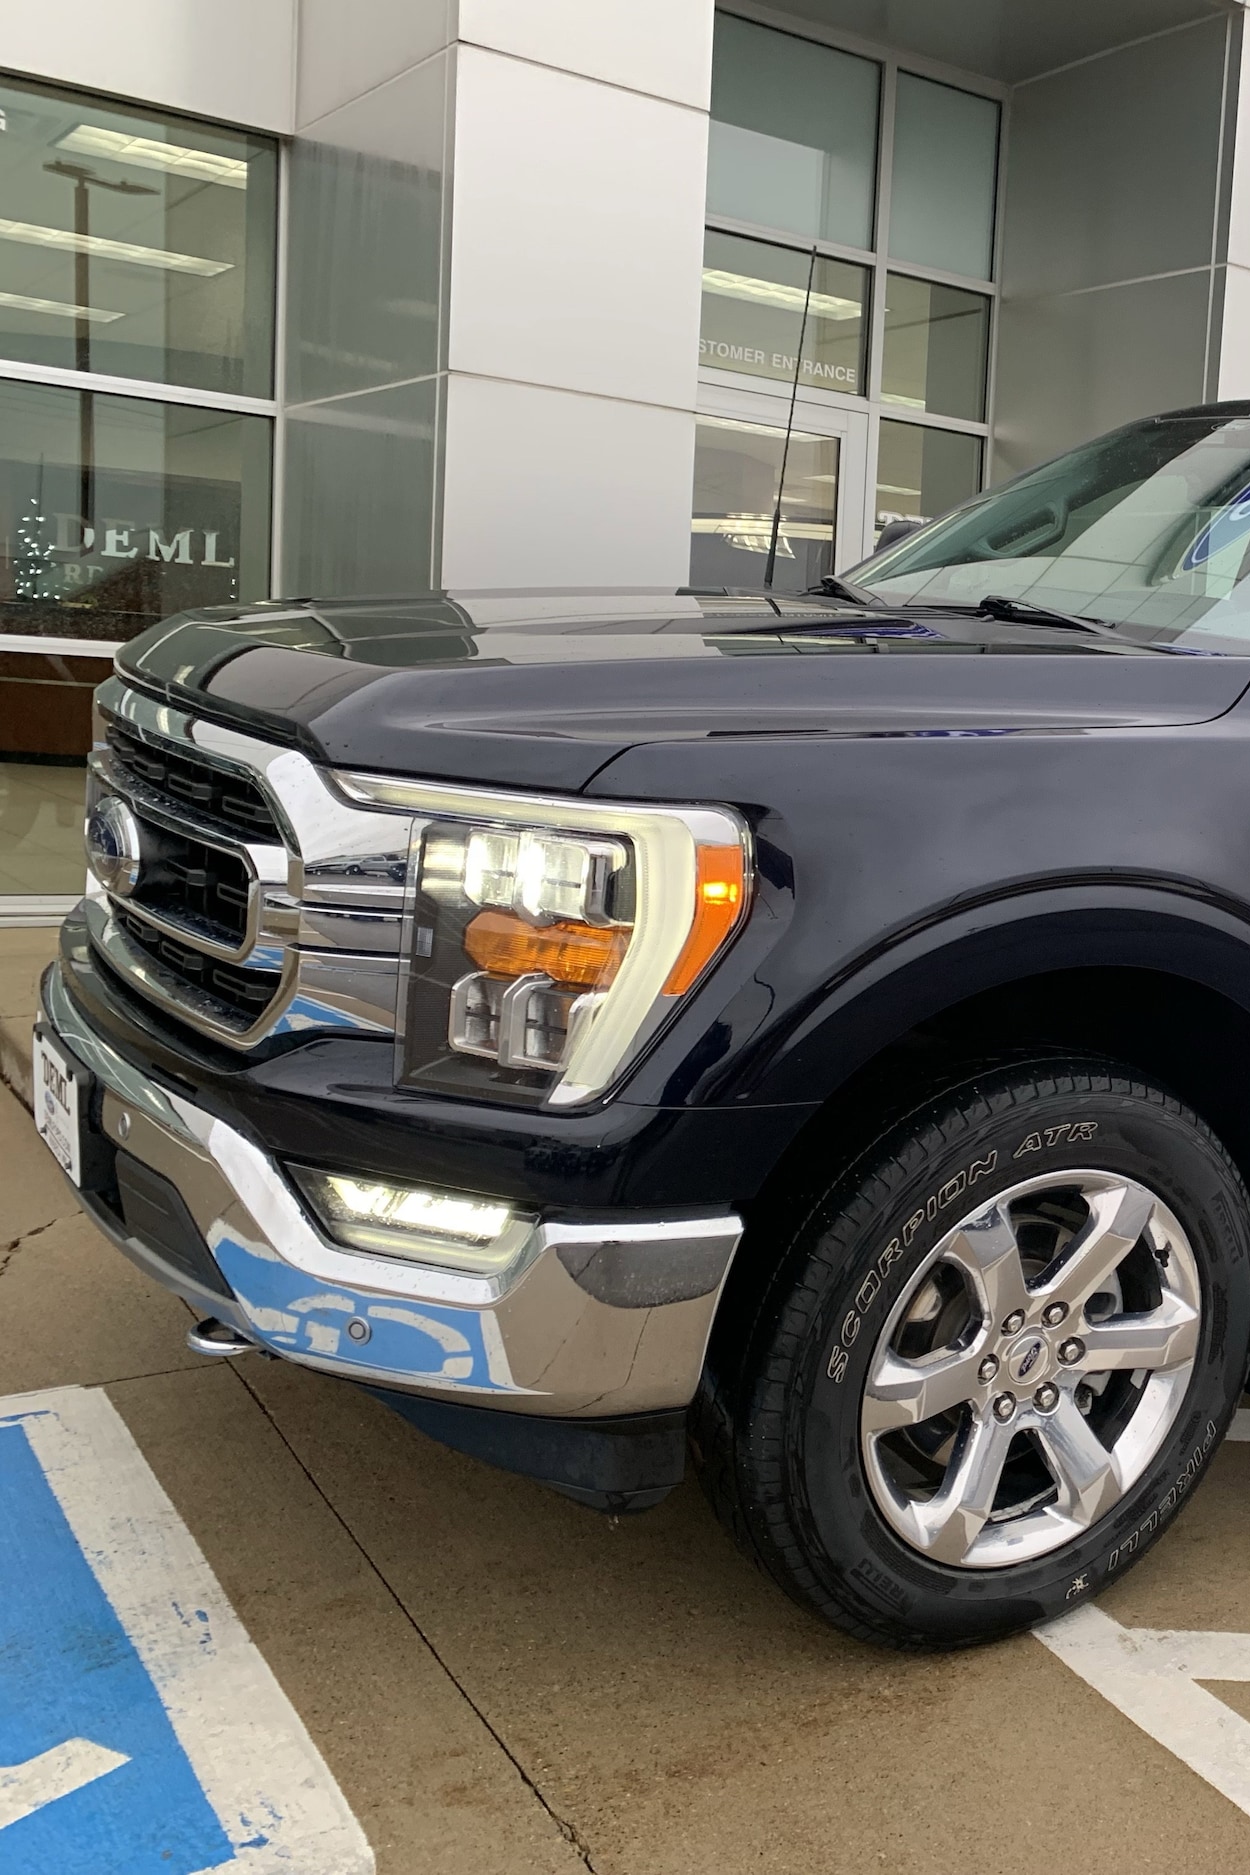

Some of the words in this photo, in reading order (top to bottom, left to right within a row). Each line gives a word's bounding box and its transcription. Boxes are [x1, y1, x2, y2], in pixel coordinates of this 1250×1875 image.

[771, 353, 856, 383] ENTRANCE
[53, 512, 235, 568] DEML
[827, 1149, 998, 1384] SCORPION
[1012, 1121, 1099, 1160] ATR
[1107, 1419, 1217, 1572] PIRELLI
